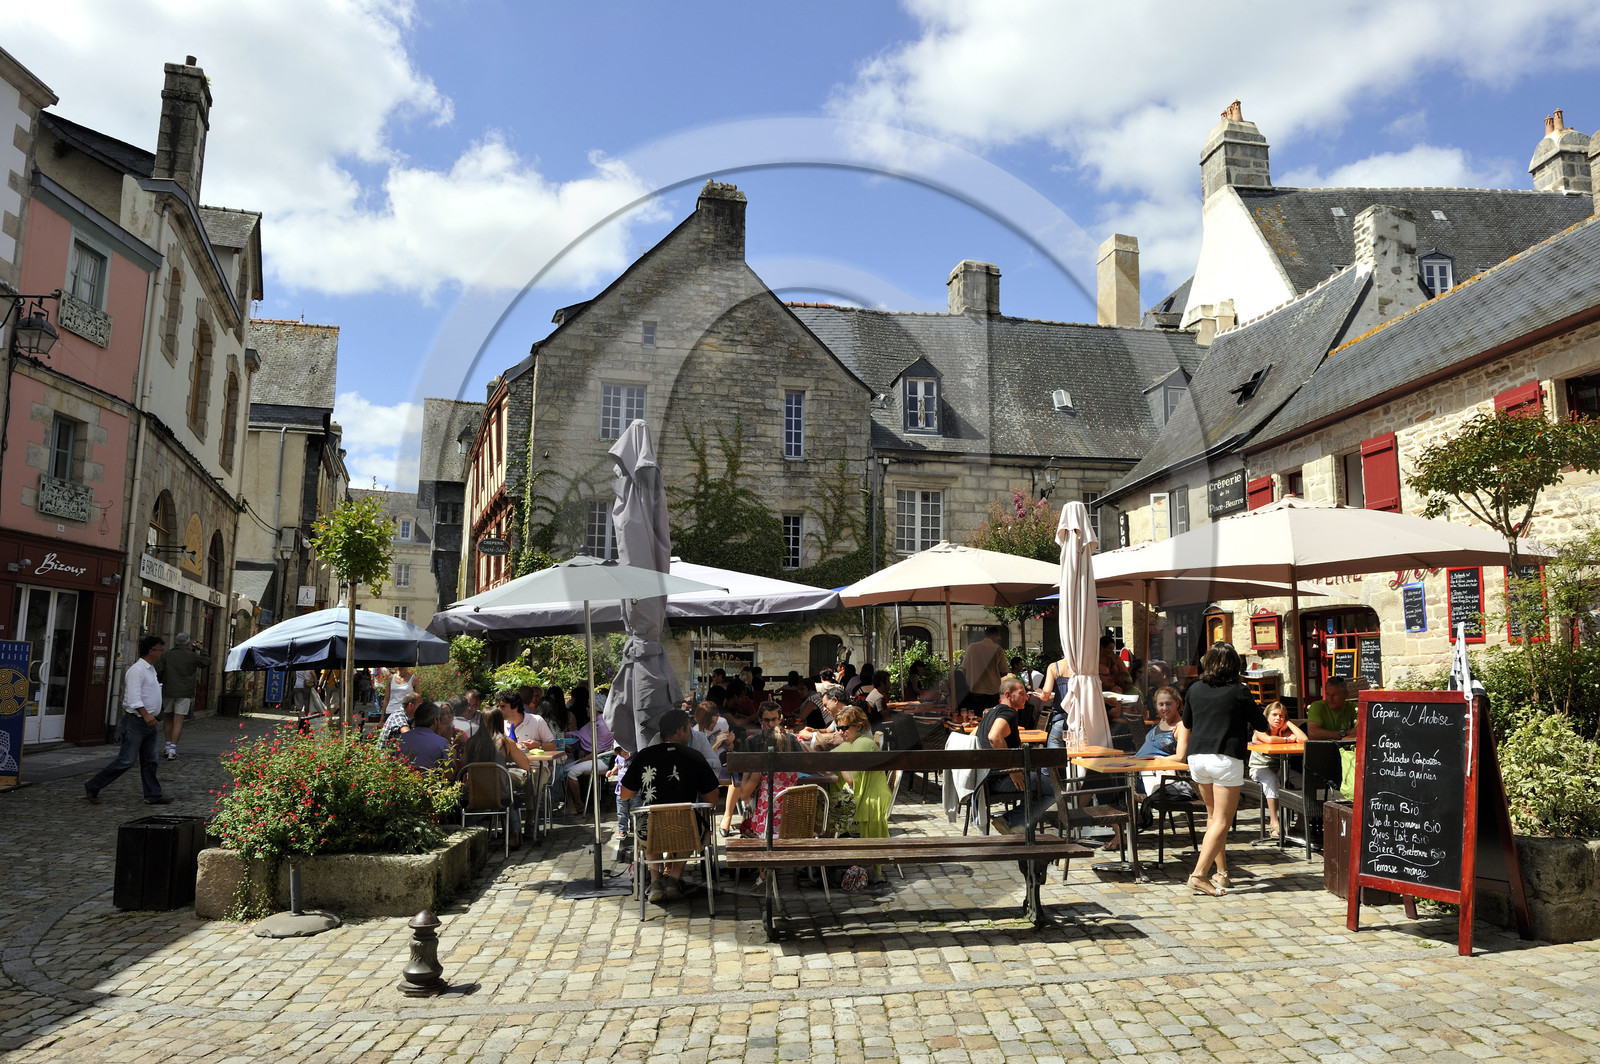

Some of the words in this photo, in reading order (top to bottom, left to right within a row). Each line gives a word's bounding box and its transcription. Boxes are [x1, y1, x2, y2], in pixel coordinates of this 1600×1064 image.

[1209, 473, 1242, 491] Crêperie
[34, 552, 87, 577] Bizoux
[1372, 703, 1401, 725] Crêperie
[1401, 705, 1454, 727] L'Ardoise
[1378, 734, 1401, 755] Crêpes
[1383, 814, 1391, 827] de
[1368, 841, 1395, 853] Bière
